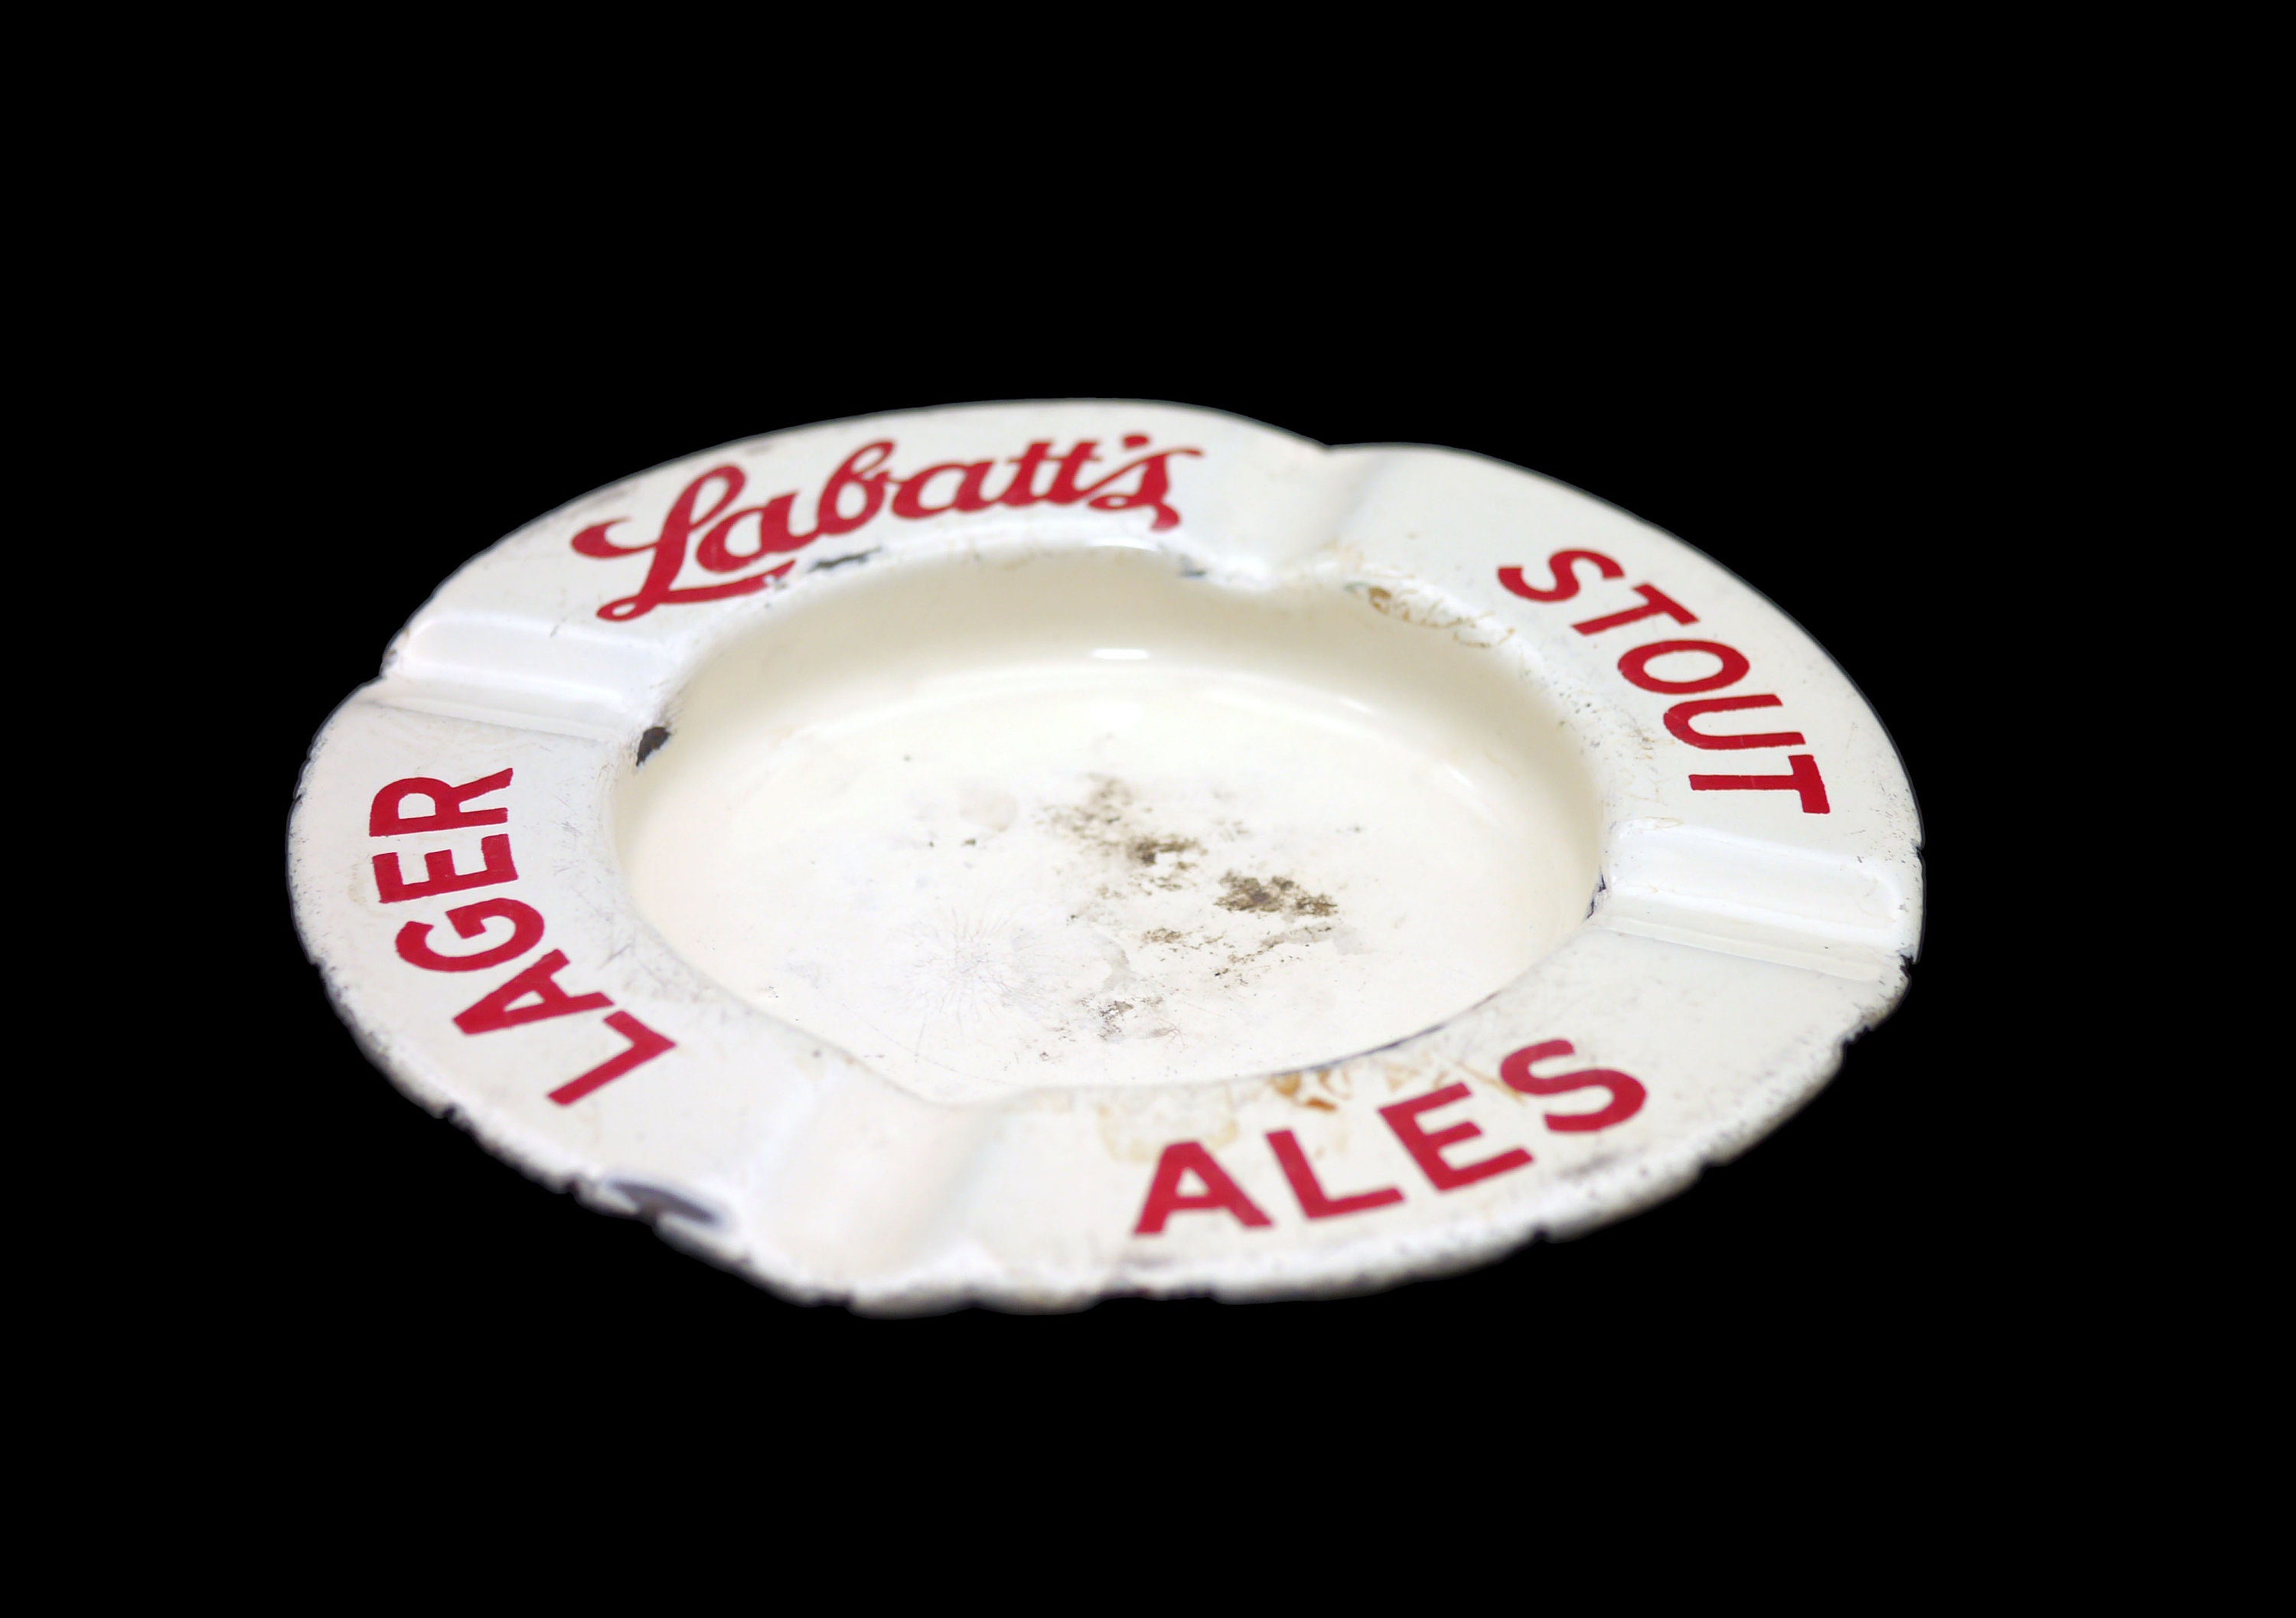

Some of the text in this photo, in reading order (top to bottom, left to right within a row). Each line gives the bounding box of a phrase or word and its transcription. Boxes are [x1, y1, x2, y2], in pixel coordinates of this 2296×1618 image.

[570, 433, 1202, 622] Labatt's
[1496, 546, 1831, 816] STOUT
[367, 765, 677, 1107] LAGER
[1133, 1038, 1649, 1236] ALES
